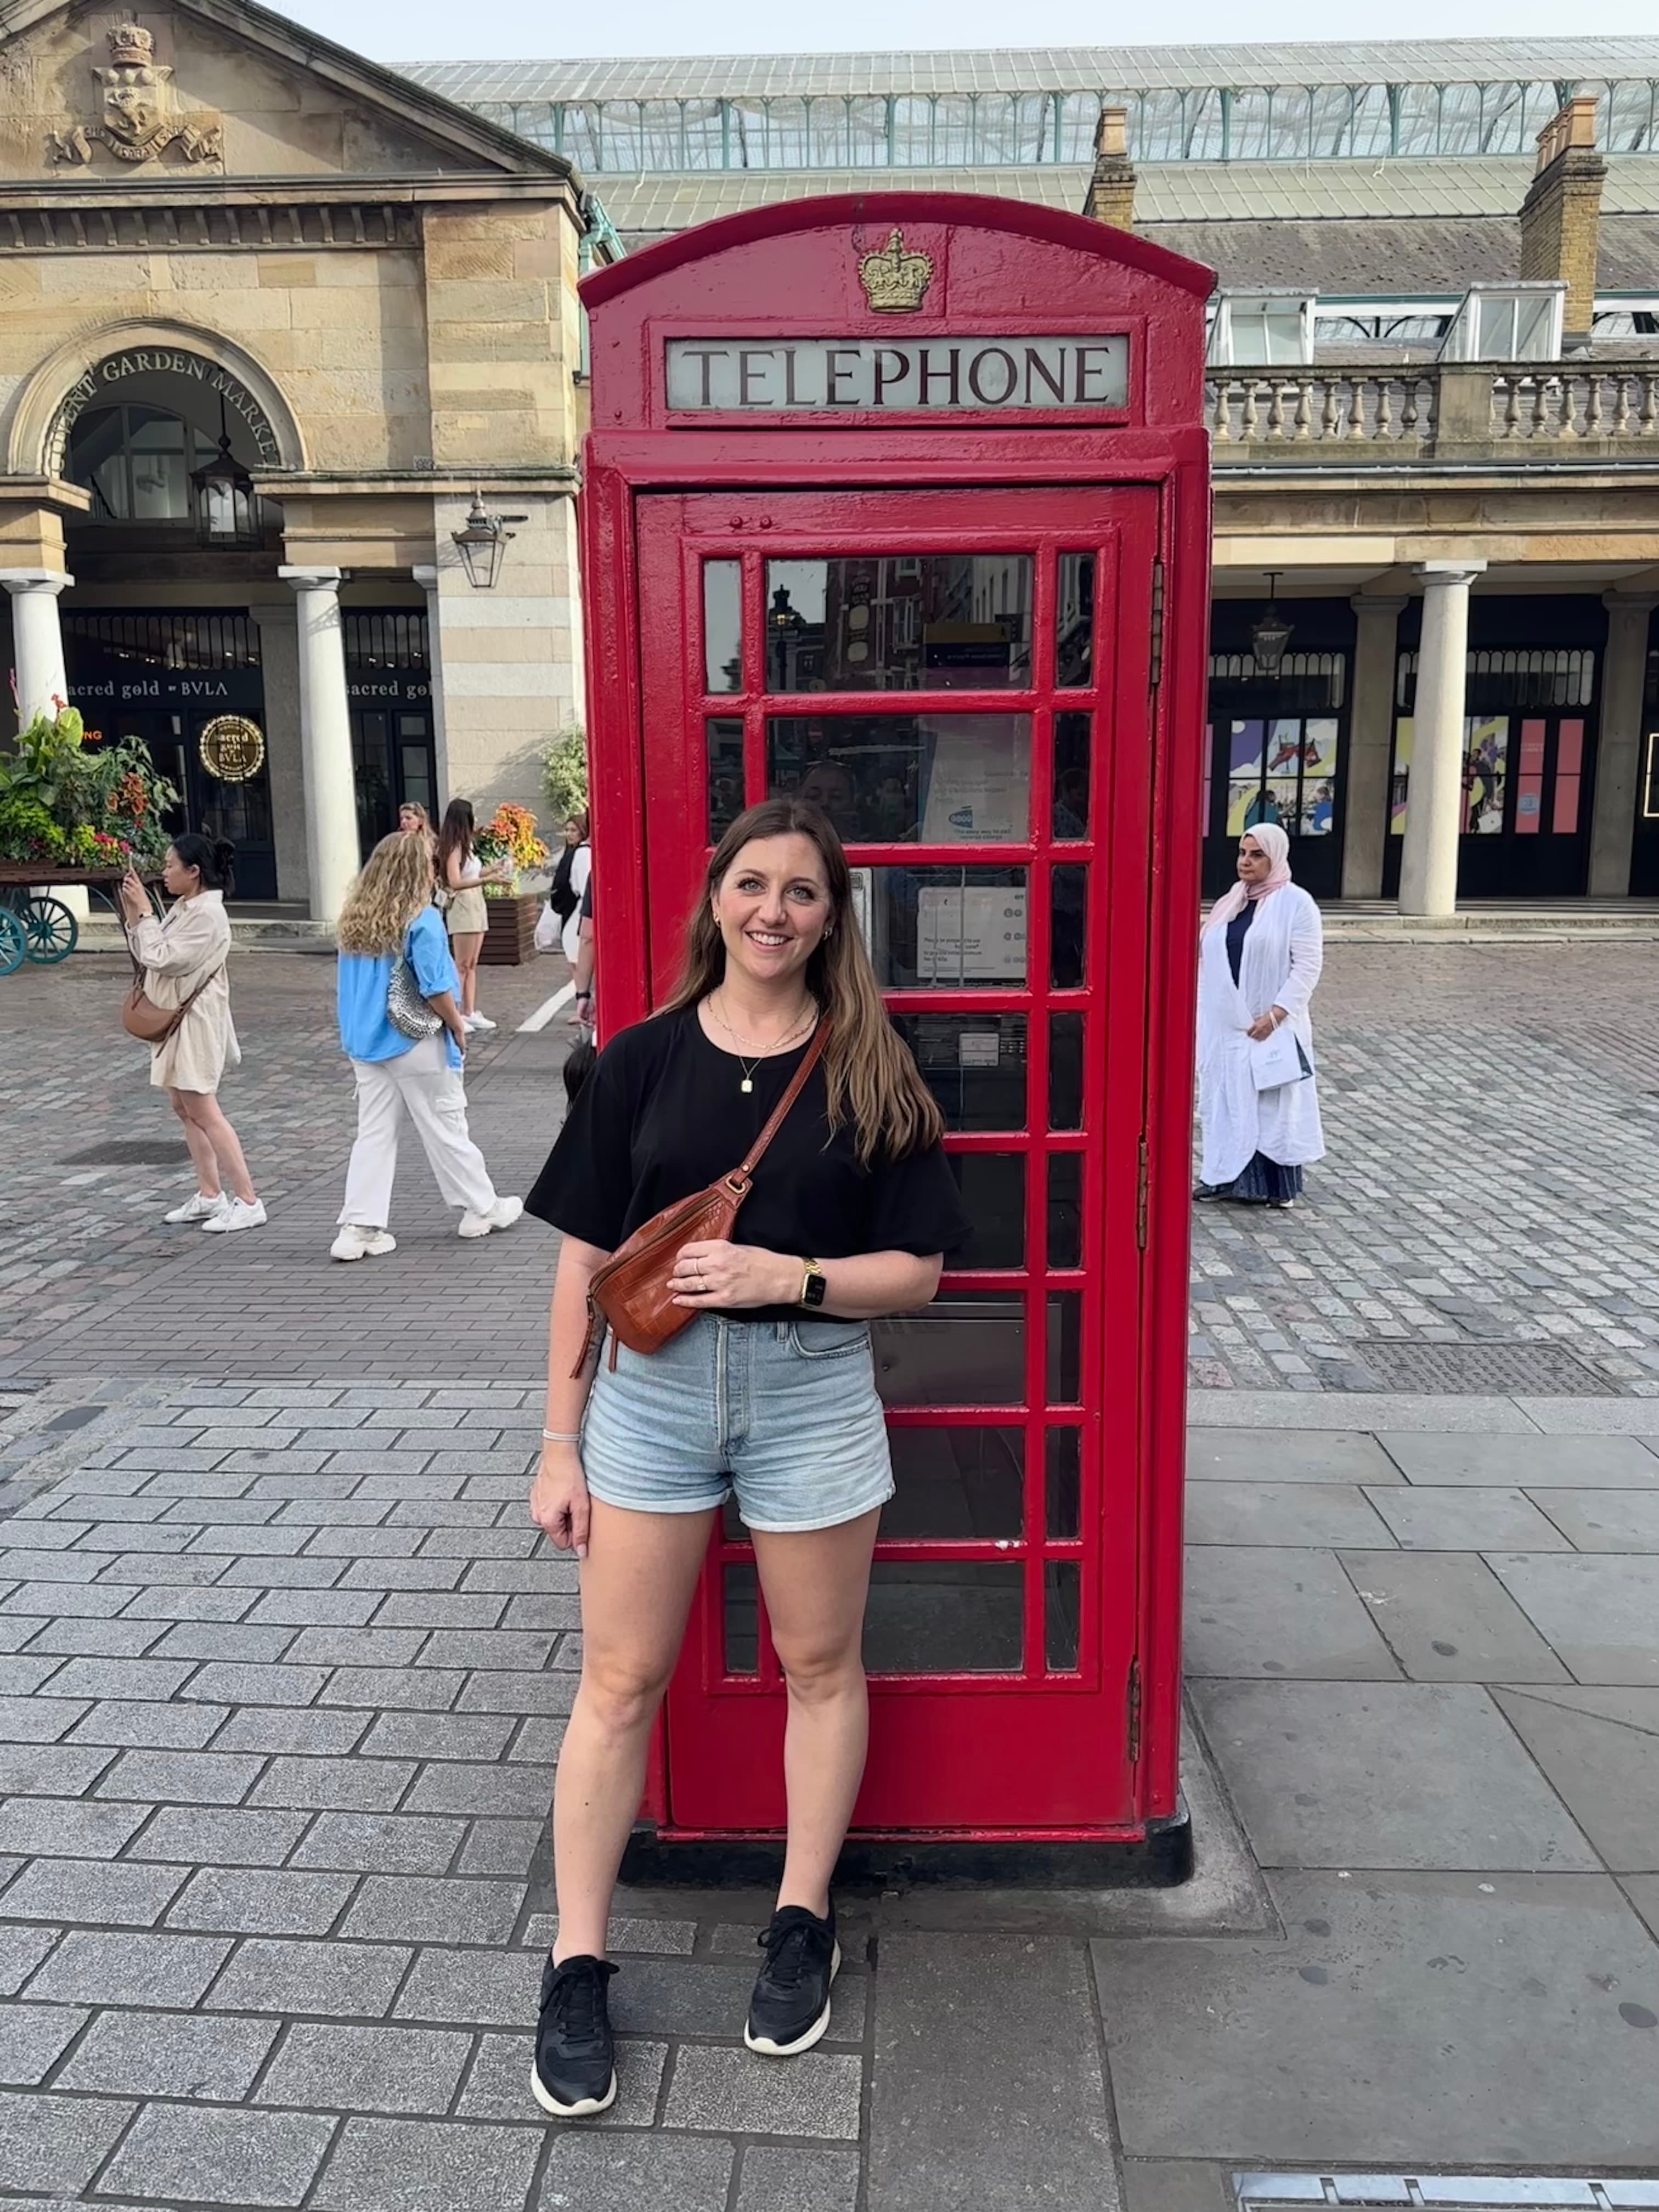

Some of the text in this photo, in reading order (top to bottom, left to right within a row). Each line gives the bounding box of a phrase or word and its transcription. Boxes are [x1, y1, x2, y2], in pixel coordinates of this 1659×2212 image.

[681, 346, 1110, 407] TELEPHONE
[50, 369, 98, 472] COVENT
[103, 352, 206, 380] GARDEN
[68, 681, 115, 696] acred
[121, 680, 160, 699] gold
[407, 680, 432, 700] gol
